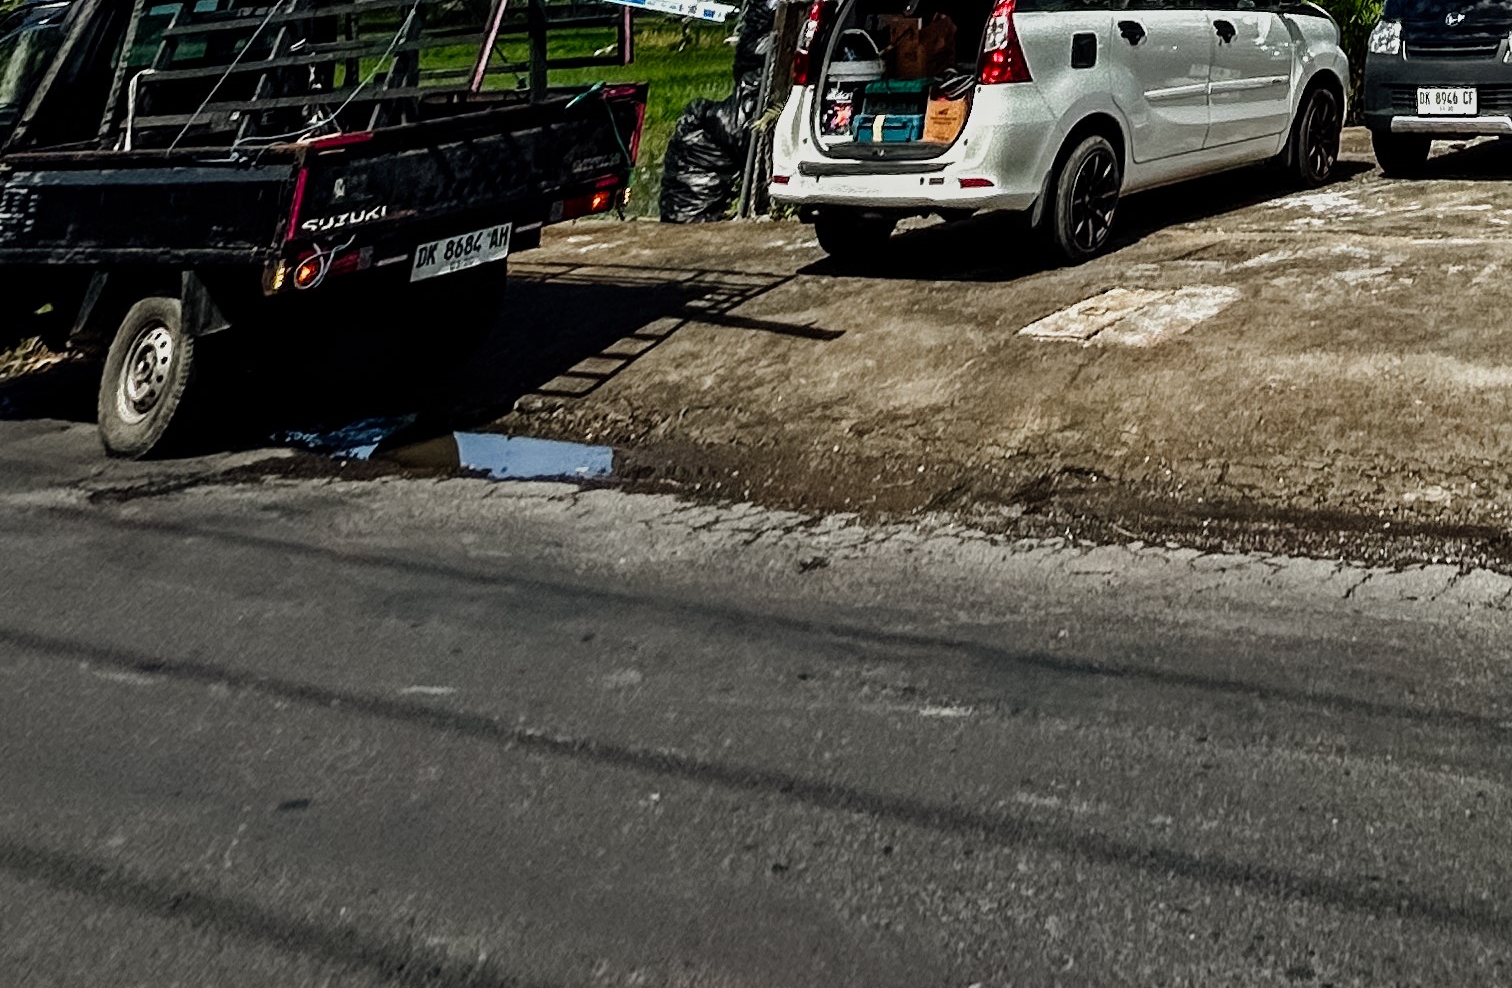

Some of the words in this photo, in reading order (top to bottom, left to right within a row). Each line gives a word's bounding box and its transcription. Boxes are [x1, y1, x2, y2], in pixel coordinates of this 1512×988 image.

[1420, 92, 1430, 105] DK
[1463, 91, 1473, 104] CF
[302, 205, 387, 231] SUZUKI
[416, 245, 436, 268] DK
[444, 231, 484, 260] 8684
[489, 226, 510, 248] AH
